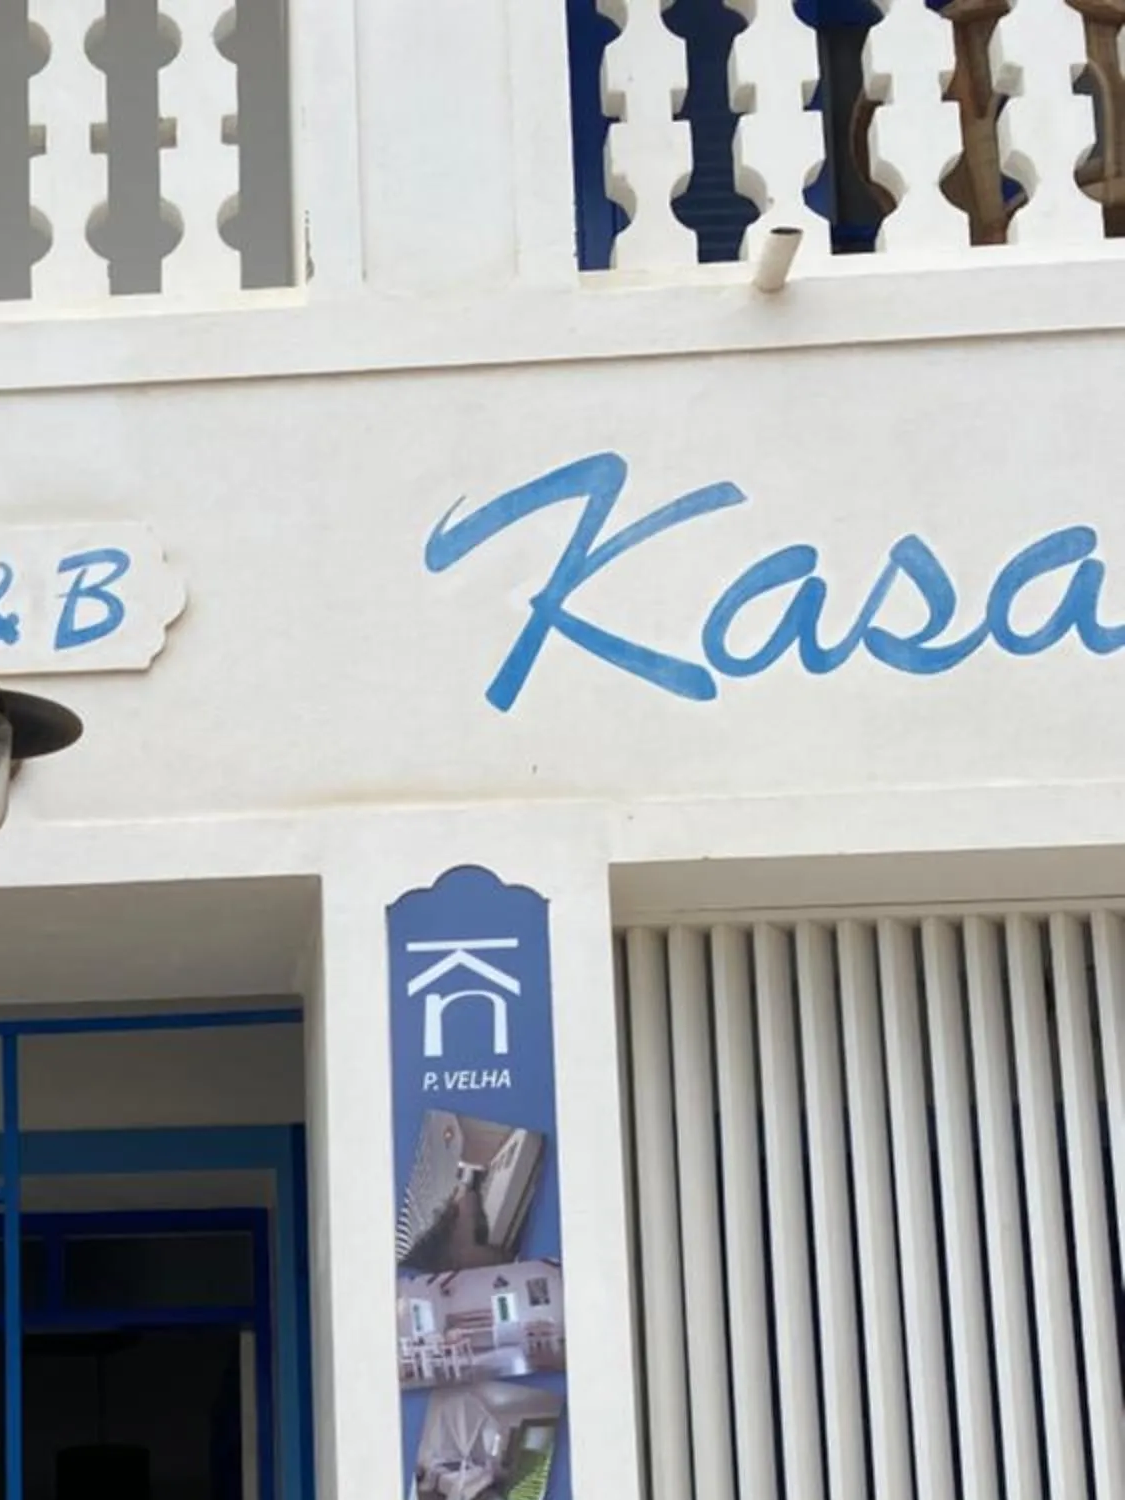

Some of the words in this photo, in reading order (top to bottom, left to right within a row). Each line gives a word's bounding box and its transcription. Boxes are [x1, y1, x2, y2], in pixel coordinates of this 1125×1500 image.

[424, 451, 1125, 713] Kasa
[423, 1071, 439, 1092] P.
[444, 1069, 512, 1090] VELHA
